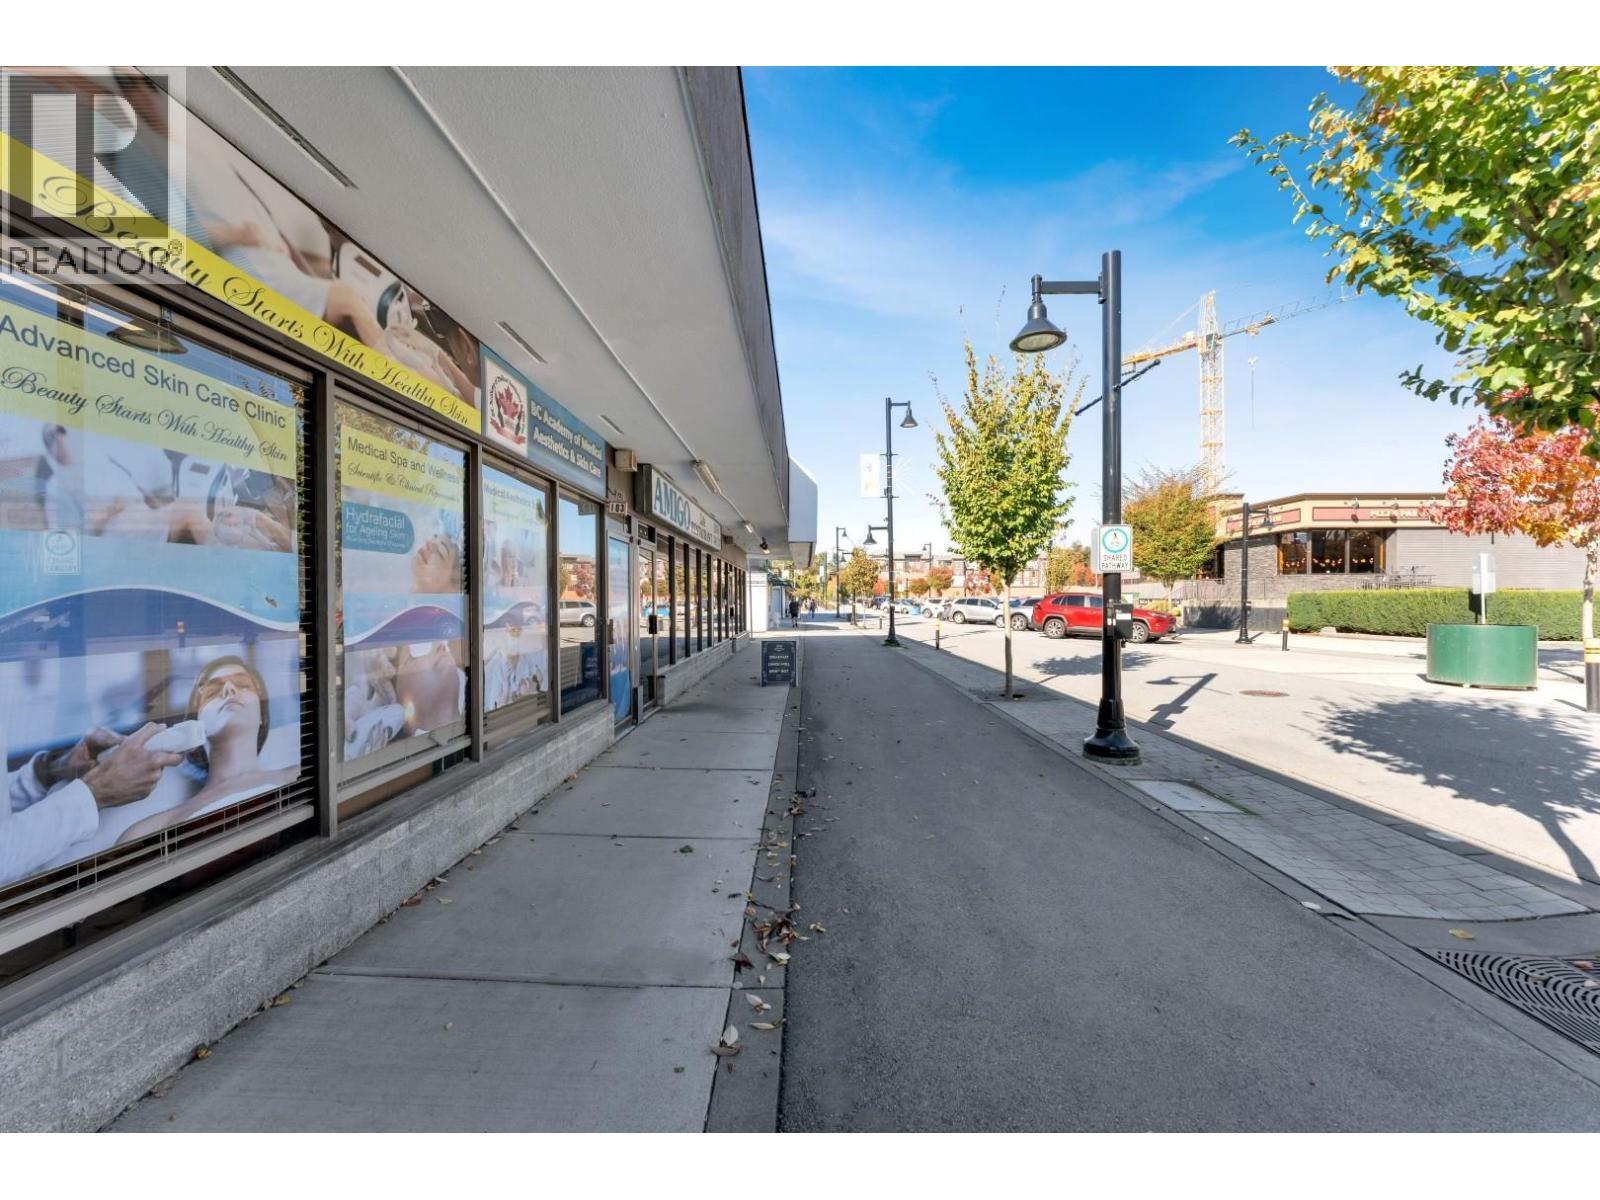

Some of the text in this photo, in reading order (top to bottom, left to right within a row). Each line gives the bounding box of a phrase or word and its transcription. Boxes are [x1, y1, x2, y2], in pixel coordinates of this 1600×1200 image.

[223, 276, 304, 339] Starts
[313, 325, 364, 370] With
[371, 356, 436, 409] Healthy
[440, 396, 469, 426] Skin
[0, 314, 287, 429] Advanced Skin Care Clinic
[1, 366, 288, 462] Beauty Starts With Healthy Skin
[530, 400, 544, 420] BC
[543, 410, 574, 444] Academy
[348, 436, 388, 461] Medical
[390, 451, 409, 468] Spa
[410, 461, 426, 474] and
[533, 427, 570, 460] Aesthetics
[345, 506, 405, 529] Hydrafacial
[610, 503, 625, 512] 103
[654, 477, 691, 531] AMIGO
[345, 521, 358, 533] for
[359, 523, 388, 540] Ageing
[1103, 554, 1128, 562] SHARED
